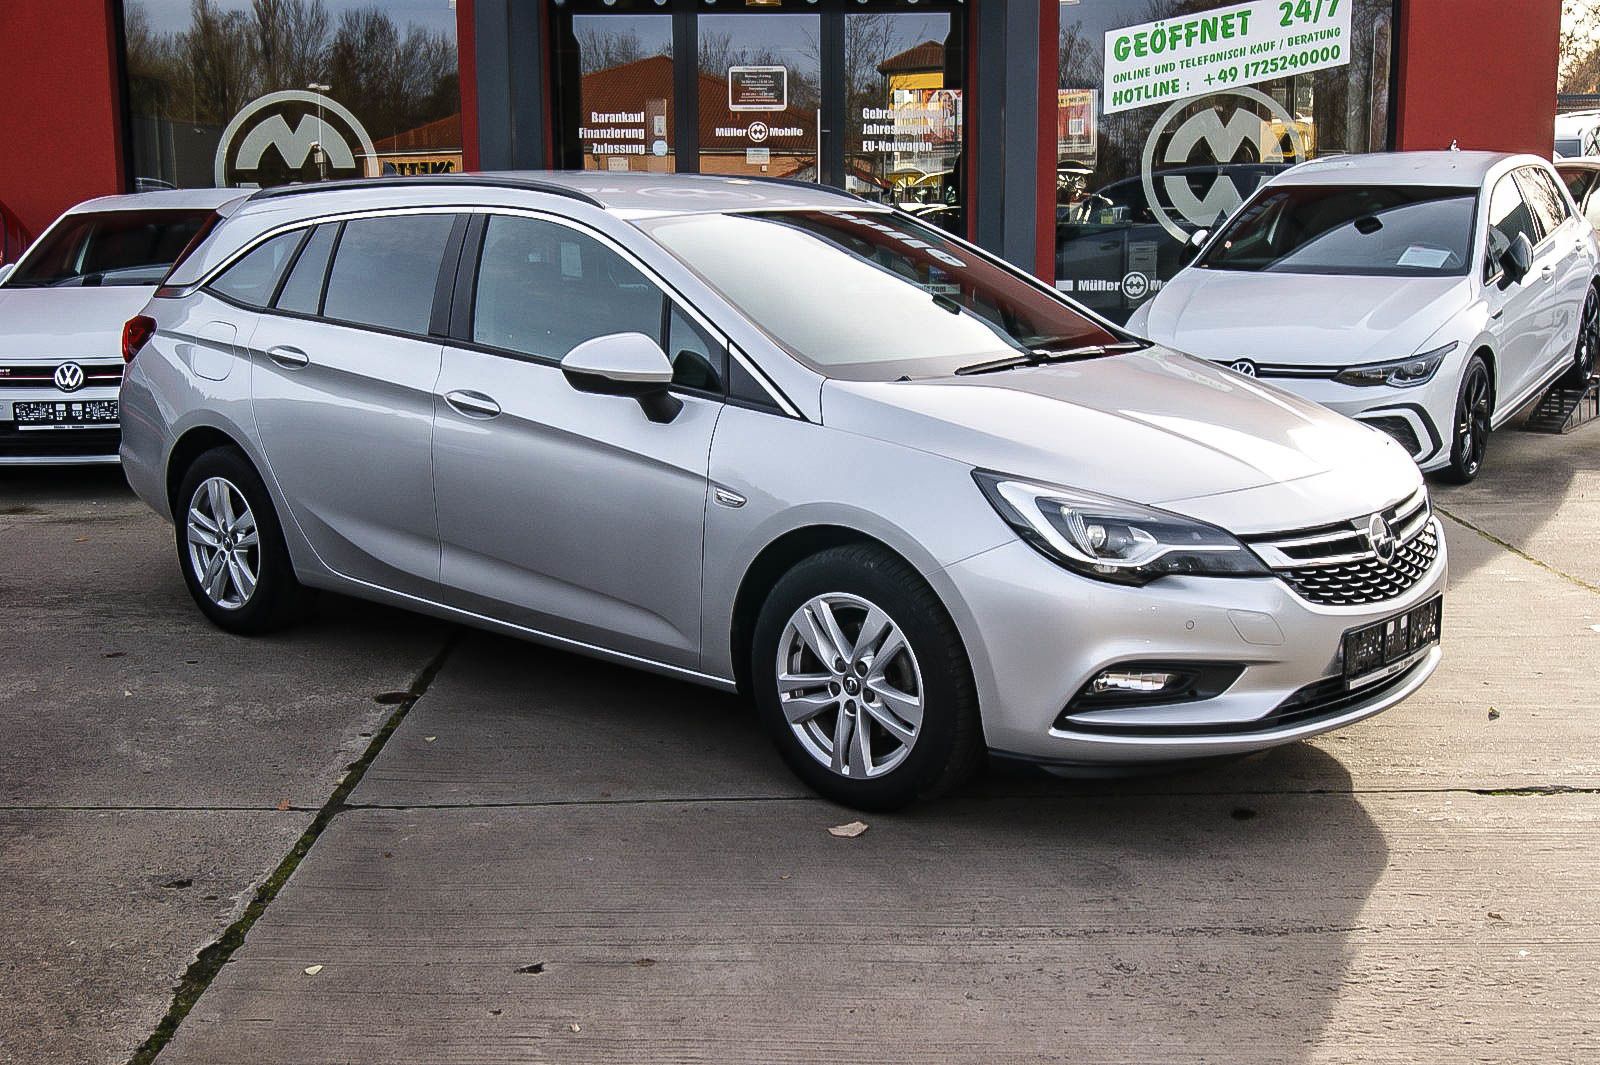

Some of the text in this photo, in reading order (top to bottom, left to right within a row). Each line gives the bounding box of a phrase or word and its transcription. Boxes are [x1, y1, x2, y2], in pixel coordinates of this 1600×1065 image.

[1114, 0, 1341, 62] GEÖFFNET 24/7
[1112, 67, 1151, 84] ONLINE
[1154, 62, 1176, 75] UND
[1179, 46, 1247, 70] TELEFONISCH
[1250, 40, 1276, 56] KAUF
[1287, 27, 1341, 47] BERATUNG
[1112, 78, 1180, 107] HOTLINE
[1203, 66, 1238, 86] +49
[1244, 44, 1341, 79] 1725240000
[578, 127, 645, 139] Finanzierung
[715, 127, 804, 137] Müller Mobile
[592, 142, 646, 155] Zulassung
[862, 140, 933, 153] EU-Neuwagen
[1078, 280, 1121, 292] Müller
